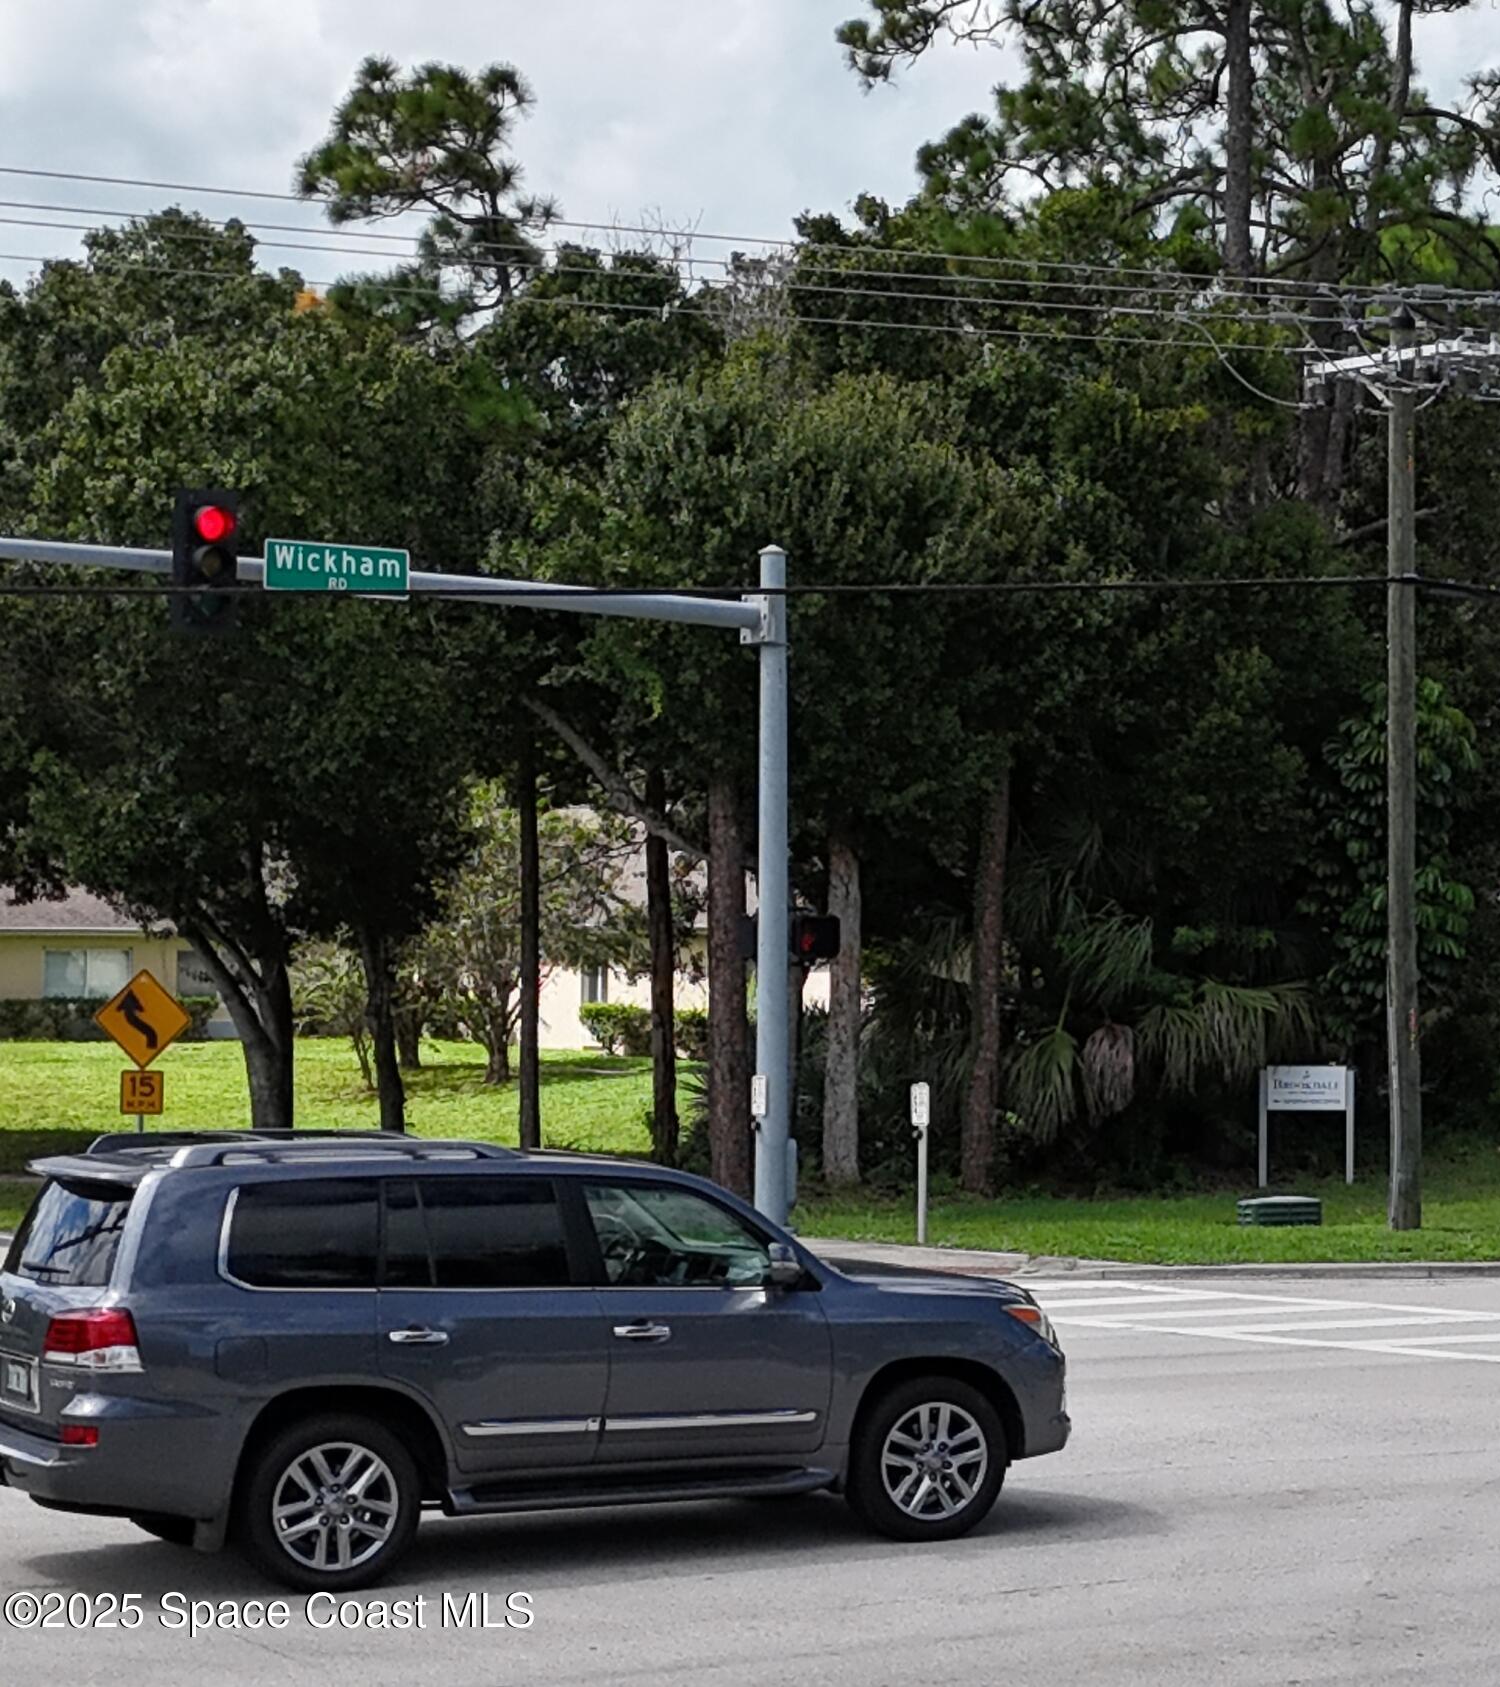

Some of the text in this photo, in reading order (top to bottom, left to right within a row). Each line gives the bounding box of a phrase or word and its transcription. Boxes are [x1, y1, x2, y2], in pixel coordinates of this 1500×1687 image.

[274, 543, 401, 579] Wickham
[327, 576, 348, 590] RD
[129, 1075, 155, 1098] 15
